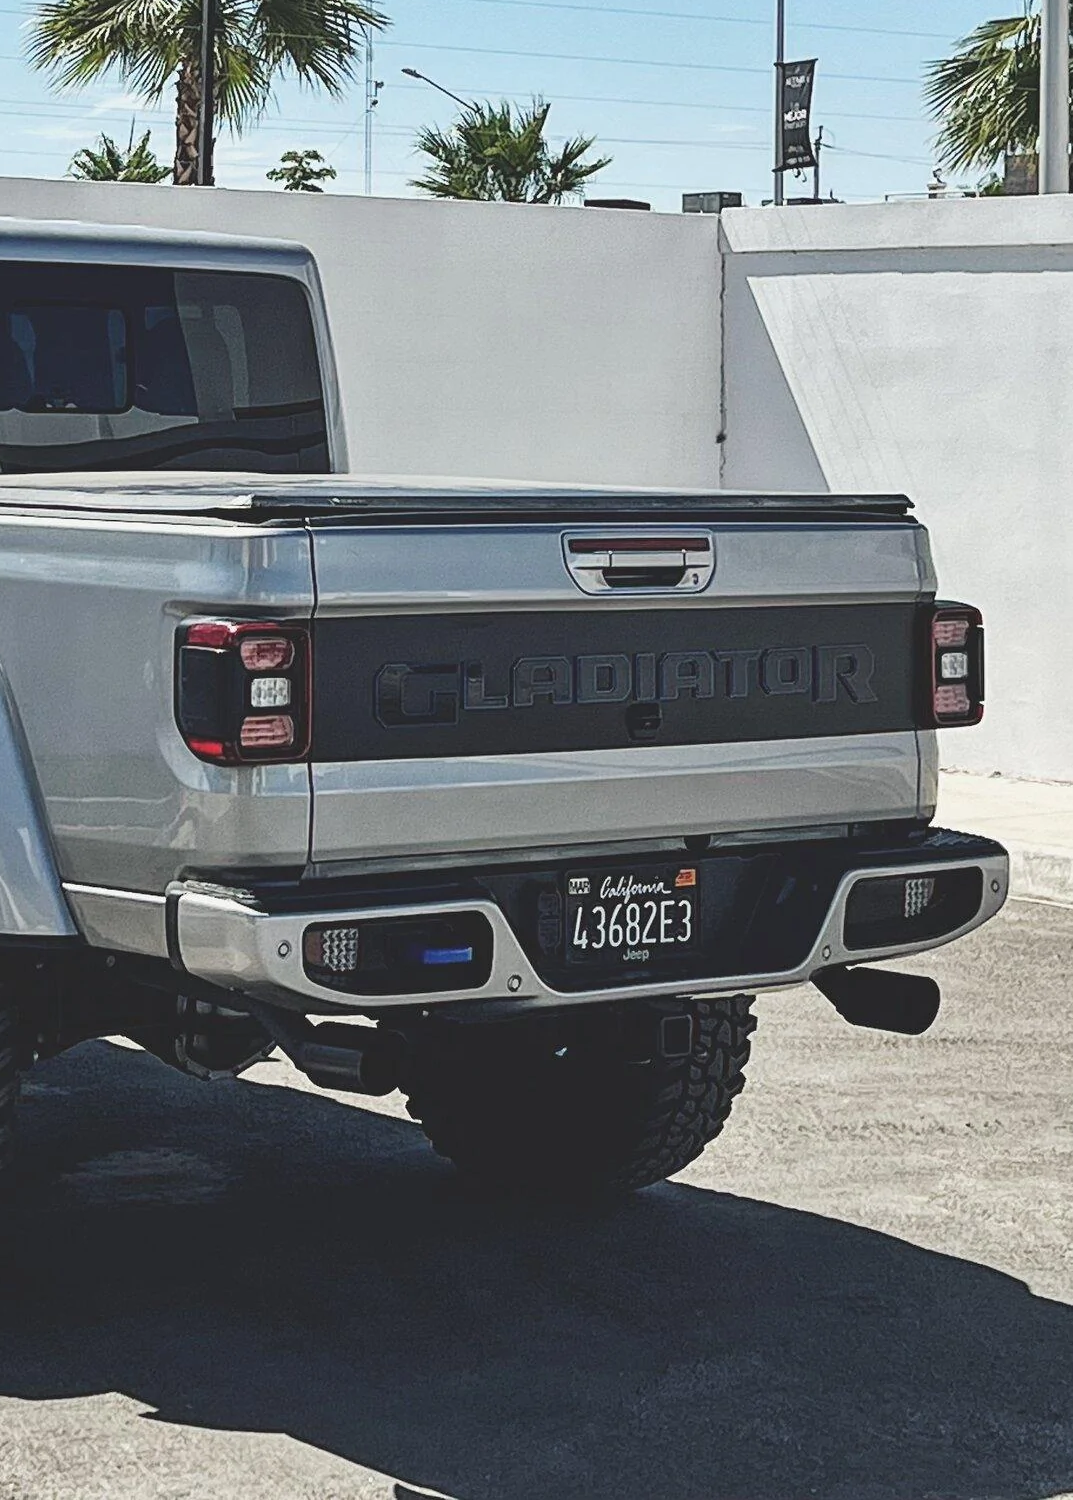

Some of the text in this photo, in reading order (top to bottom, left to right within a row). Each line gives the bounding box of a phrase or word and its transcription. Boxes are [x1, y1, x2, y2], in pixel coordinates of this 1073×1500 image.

[373, 644, 878, 730] GLADIATOR
[600, 875, 672, 904] California
[573, 899, 692, 949] 43682E3
[622, 947, 650, 962] Jeep
